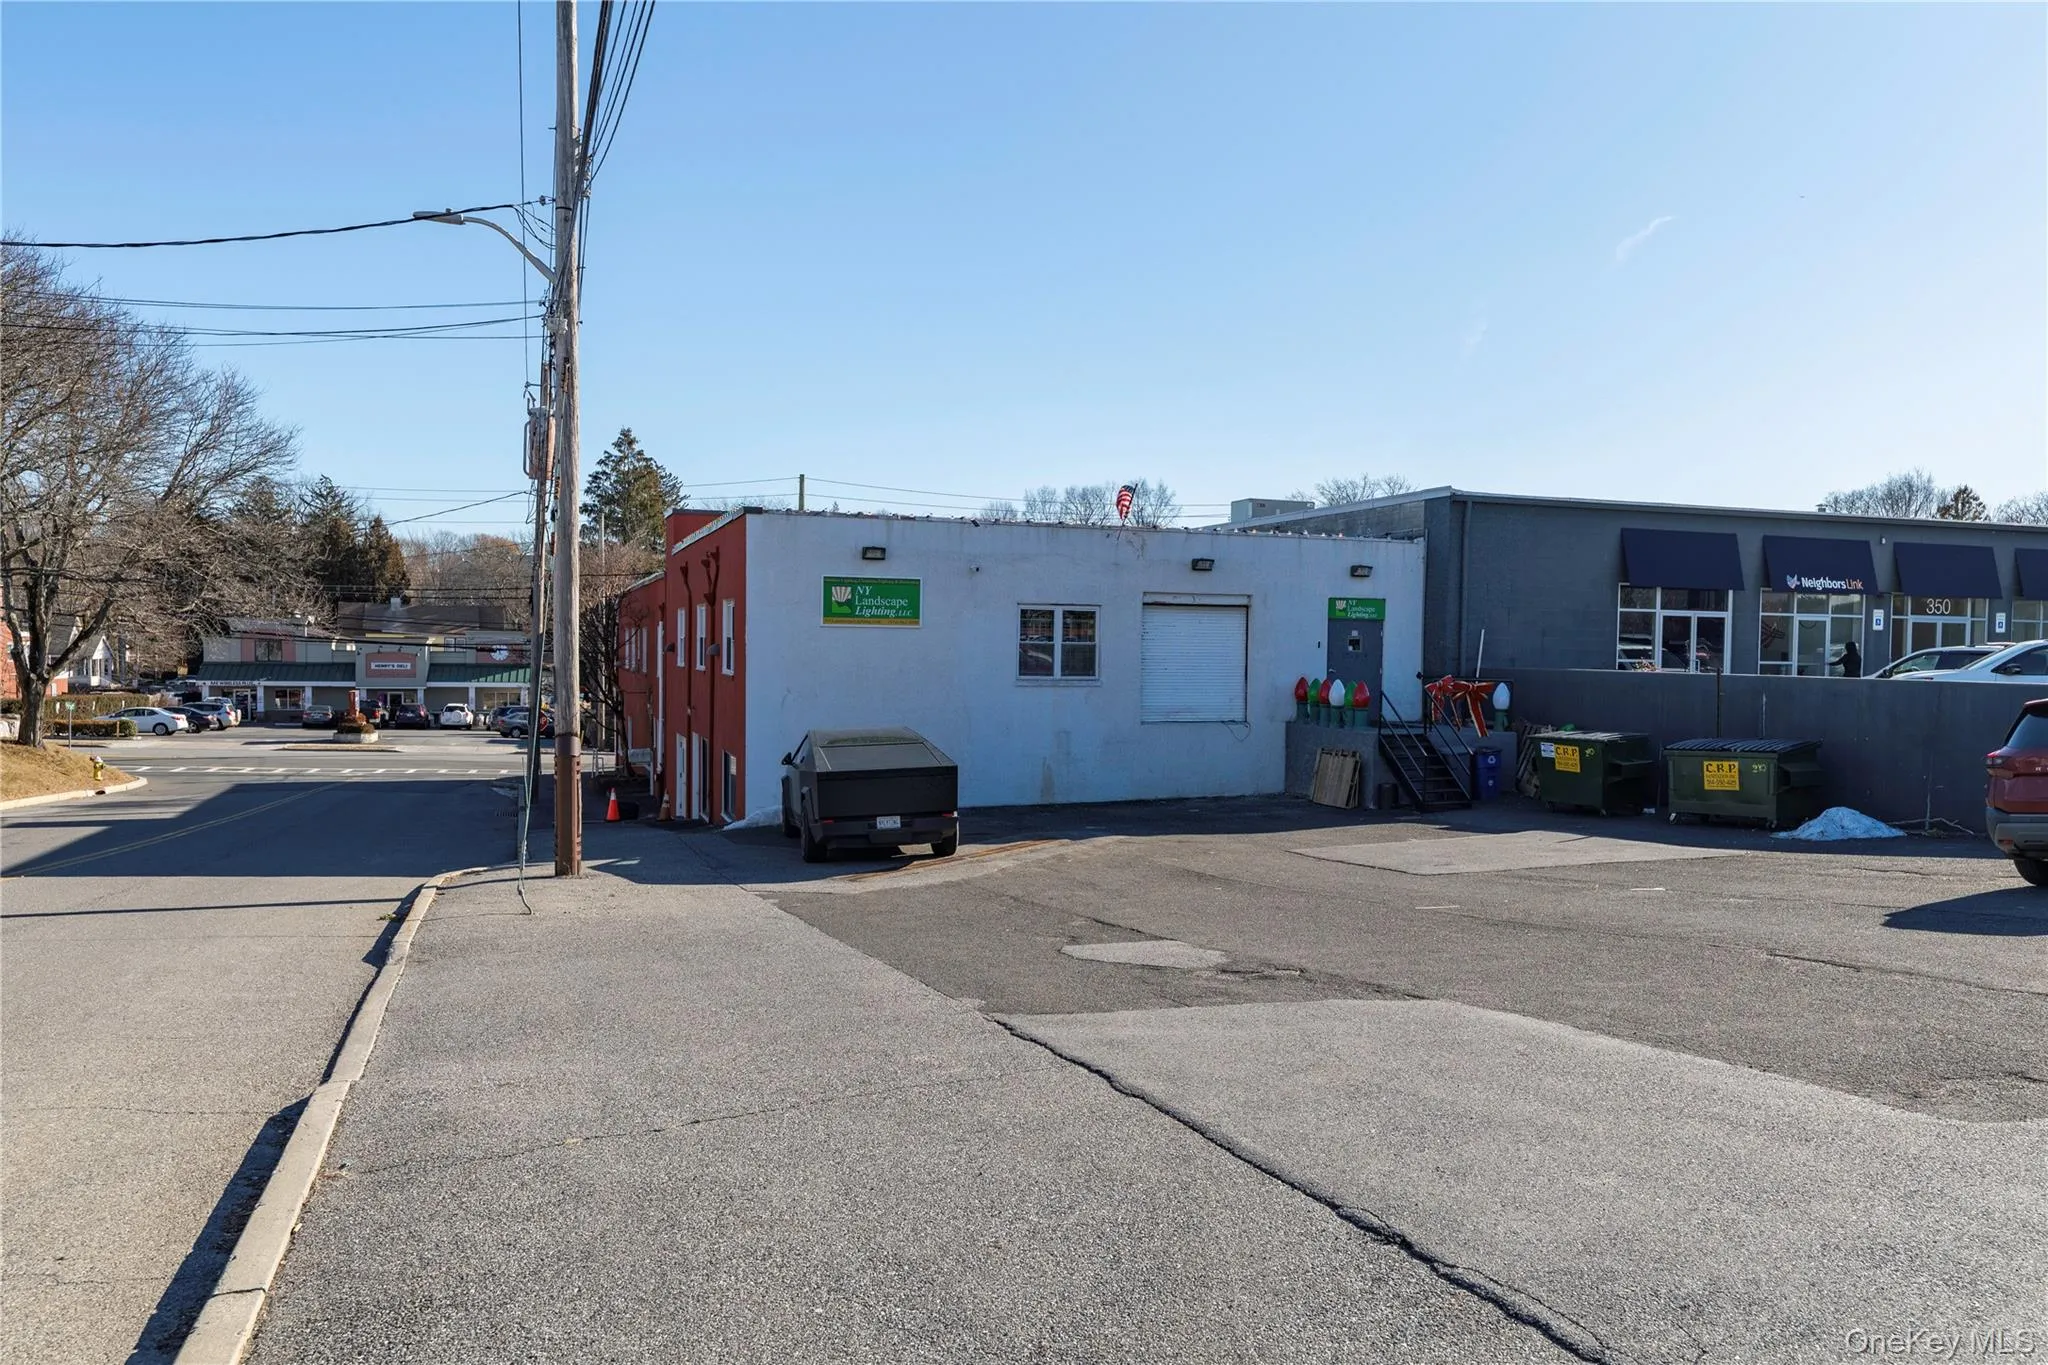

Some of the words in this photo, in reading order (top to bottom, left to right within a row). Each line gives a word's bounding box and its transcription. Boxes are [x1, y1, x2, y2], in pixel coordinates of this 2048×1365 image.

[855, 585, 873, 595] NY
[855, 596, 909, 609] Landscape
[1926, 598, 1951, 615] 350
[1705, 763, 1737, 773] C.R.P.
